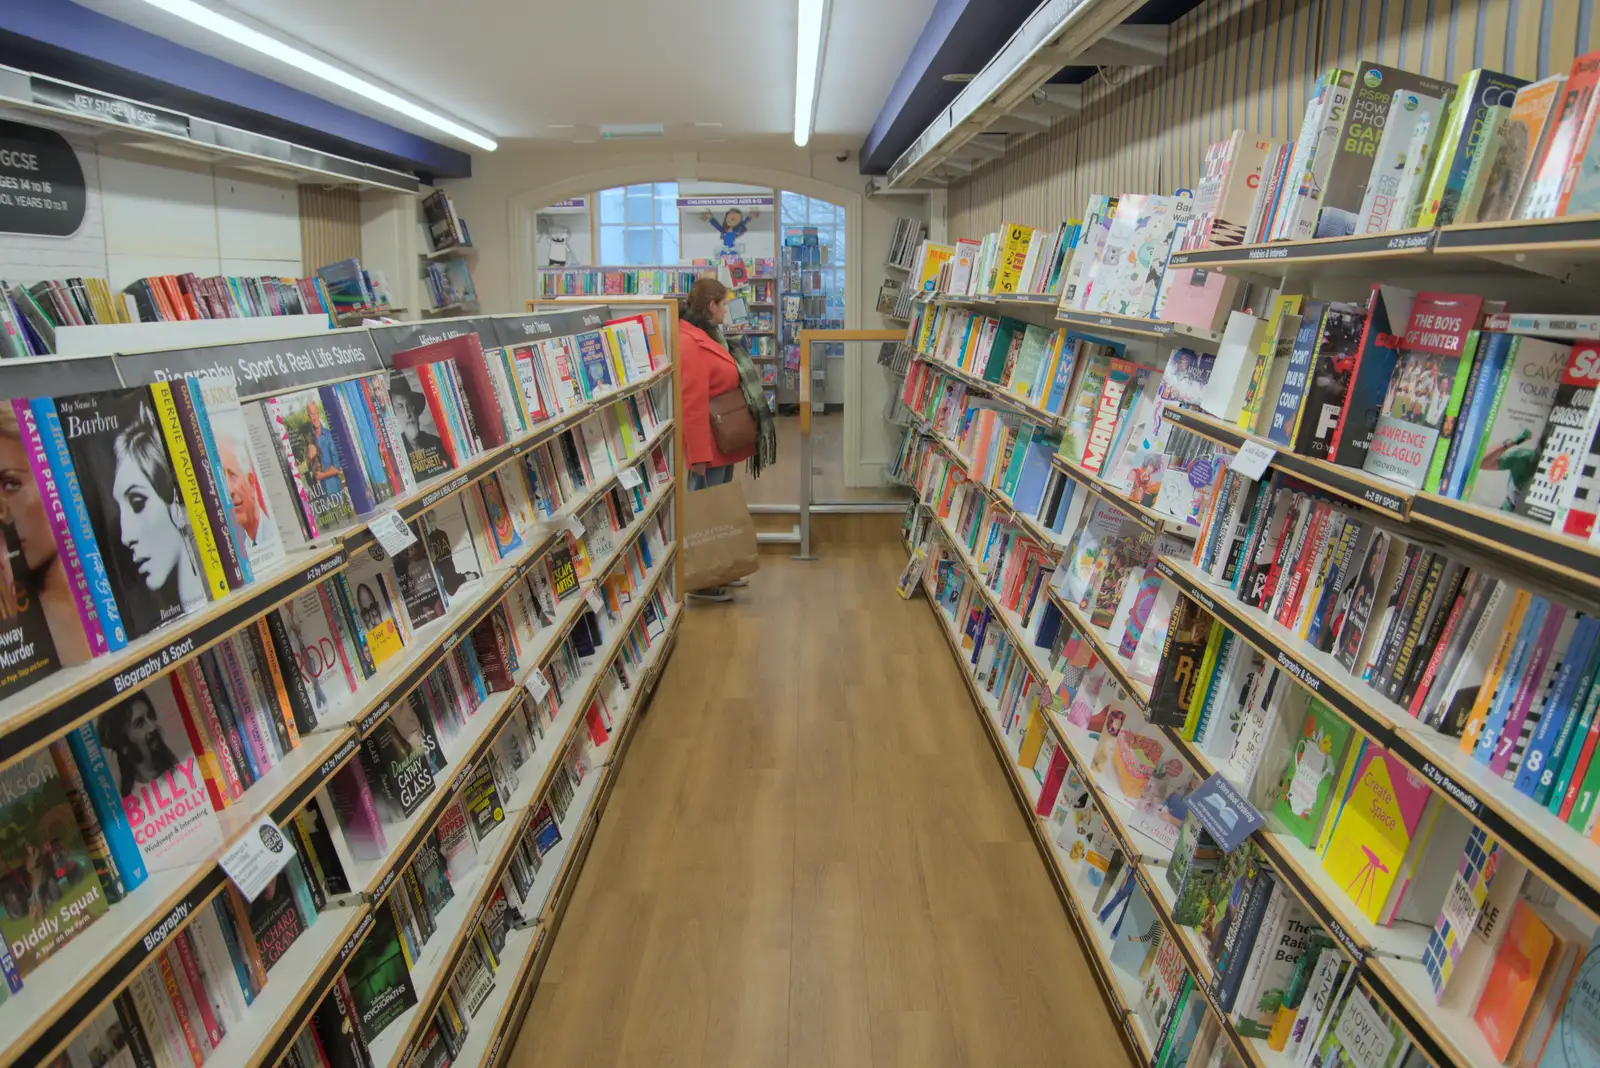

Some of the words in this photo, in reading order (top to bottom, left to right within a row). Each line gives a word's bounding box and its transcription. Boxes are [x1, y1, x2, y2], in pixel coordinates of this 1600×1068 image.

[1355, 99, 1387, 113] HOW
[1359, 89, 1389, 103] RSPB
[1, 151, 39, 171] GCSE
[14, 195, 41, 207] YEARS
[1415, 314, 1433, 329] THE
[1434, 315, 1462, 332] BOYS
[1406, 331, 1420, 343] OF
[1420, 333, 1459, 350] WINTER
[240, 358, 276, 383] Sport
[279, 356, 288, 372] &
[288, 351, 315, 372] Real
[317, 347, 335, 367] Life
[335, 345, 365, 364] Stories
[1519, 382, 1551, 396] TOUR
[60, 402, 73, 414] My
[74, 400, 91, 411] Name
[180, 384, 192, 409] DAN
[189, 411, 207, 457] WALKER
[67, 412, 119, 439] Barbra
[1083, 381, 1128, 471] MANGA
[1376, 424, 1428, 448] LAWRENCE
[161, 388, 183, 444] BERNIE
[179, 450, 201, 506] TAUPIN
[1370, 440, 1422, 467] DALLAGLIO
[46, 412, 71, 466] Linda
[64, 471, 93, 540] Robson
[412, 454, 442, 475] PRATCHETT
[1381, 461, 1395, 473] OWEN
[1396, 465, 1410, 477] SLOT
[23, 409, 48, 463] KATIE
[41, 468, 66, 522] PRICE
[62, 530, 81, 567] THIS
[76, 572, 88, 590] IS
[82, 594, 98, 620] ME
[1365, 490, 1375, 500] A-Z
[1375, 493, 1382, 503] BY
[1382, 495, 1400, 511] SPORT
[1254, 521, 1270, 563] KEANE
[1350, 525, 1361, 547] PETER
[320, 555, 343, 574] Personality
[551, 561, 572, 579] ESCAPE
[1305, 536, 1321, 573] NEVILLE
[1332, 545, 1352, 592] SCHMEICHEL
[556, 576, 576, 595] ARTIST
[1276, 552, 1293, 597] MARADONA
[1286, 571, 1302, 607] INTENSITY
[1488, 584, 1501, 606] IAN
[160, 604, 181, 620] Barbra
[1168, 604, 1181, 635] REPAIR
[0, 626, 24, 646] Away
[1386, 619, 1407, 669] TOURIST
[1468, 606, 1493, 651] WRIGHT
[0, 642, 36, 669] Murder
[1163, 636, 1172, 658] SHOP
[114, 655, 161, 692] Biography
[162, 651, 170, 662] &
[170, 637, 194, 659] Sport
[276, 621, 293, 662] PATRICK
[291, 664, 310, 710] STEWART
[1278, 652, 1302, 678] Biography
[1305, 672, 1321, 690] Sport
[1423, 642, 1447, 687] WENGER
[202, 692, 218, 722] MAY
[213, 725, 239, 782] COOPER
[1467, 719, 1479, 736] 4
[1482, 729, 1495, 749] 5
[321, 764, 331, 776] A-Z
[335, 740, 356, 764] Personality
[1499, 737, 1513, 756] 7
[1526, 750, 1543, 772] 8
[398, 757, 423, 789] CATHY
[401, 769, 432, 807] GLASS
[1364, 772, 1392, 804] Create
[1422, 763, 1434, 776] A-Z
[1433, 769, 1443, 785] by
[1442, 777, 1480, 812] Personality
[1541, 769, 1553, 786] 8
[122, 757, 197, 828] BILLY
[1579, 791, 1592, 813] 1
[134, 790, 207, 845] CONNOLLY
[438, 816, 465, 840] RIPPER
[1237, 801, 1255, 823] Ordering
[1370, 798, 1396, 831] Space
[144, 830, 174, 854] Windswept
[174, 826, 180, 834] &
[180, 808, 208, 829] Interesting
[1454, 879, 1477, 919] WORDLE
[12, 916, 60, 959] Diddly
[59, 885, 100, 923] Squat
[143, 903, 189, 952] Biography
[256, 907, 295, 954] RICHARD
[341, 947, 349, 958] A-Z
[353, 915, 373, 943] Personality
[1288, 919, 1309, 934] The
[268, 923, 300, 961] GRANT
[1330, 920, 1340, 932] A-Z
[1338, 929, 1348, 941] by
[1346, 936, 1364, 961] Subject
[1312, 957, 1336, 1013] LAND
[363, 983, 406, 1023] PSYCHOPATHS
[1349, 1004, 1371, 1036] HOW
[1371, 1032, 1385, 1058] TO
